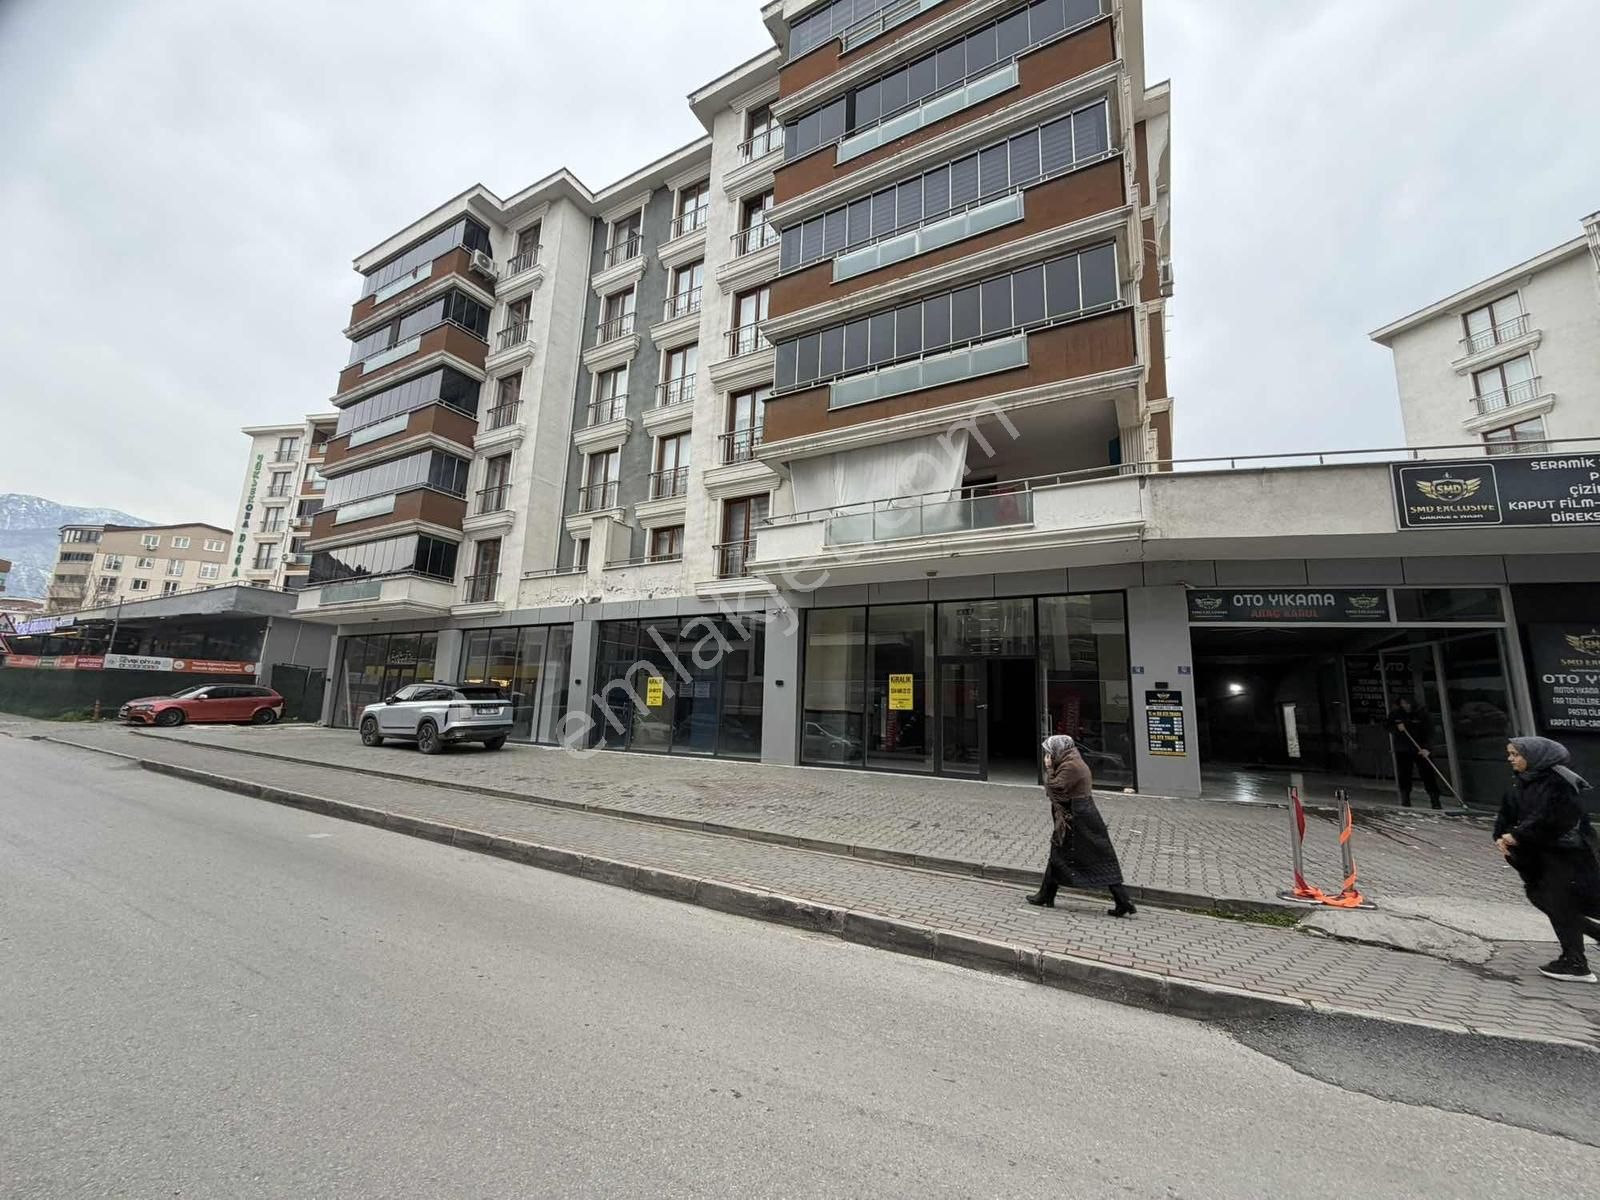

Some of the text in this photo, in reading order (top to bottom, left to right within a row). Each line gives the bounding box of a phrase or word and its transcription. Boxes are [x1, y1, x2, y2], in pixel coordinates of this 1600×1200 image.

[1530, 457, 1596, 470] SERAMİK
[1410, 504, 1496, 514] SMD EXCLUSIVE
[1508, 500, 1556, 510] KAPUT
[1233, 594, 1336, 607] OTO YIKAMA
[1542, 674, 1580, 684] OTO
